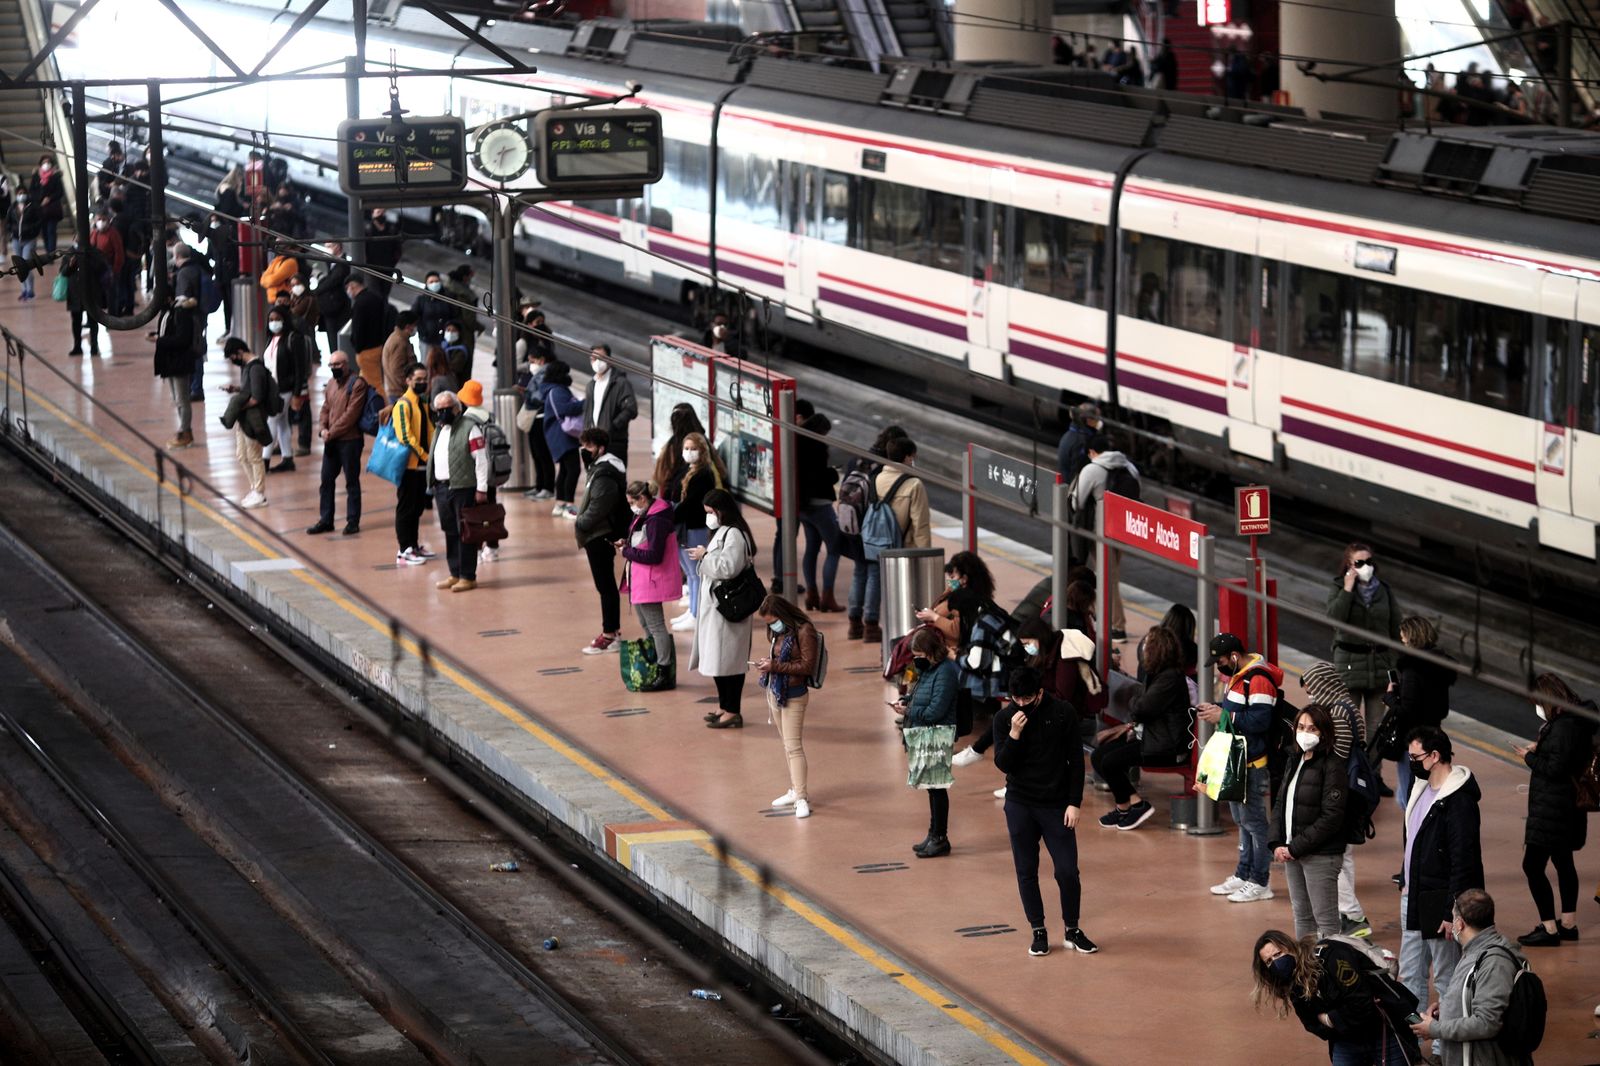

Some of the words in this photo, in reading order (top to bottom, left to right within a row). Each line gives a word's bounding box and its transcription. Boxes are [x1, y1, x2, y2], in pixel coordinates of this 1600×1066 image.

[601, 121, 611, 134] 4
[1002, 468, 1016, 488] Salida
[1125, 510, 1149, 540] Madrid
[1155, 521, 1180, 551] Atocha
[1241, 523, 1268, 531] EXTINTOR
